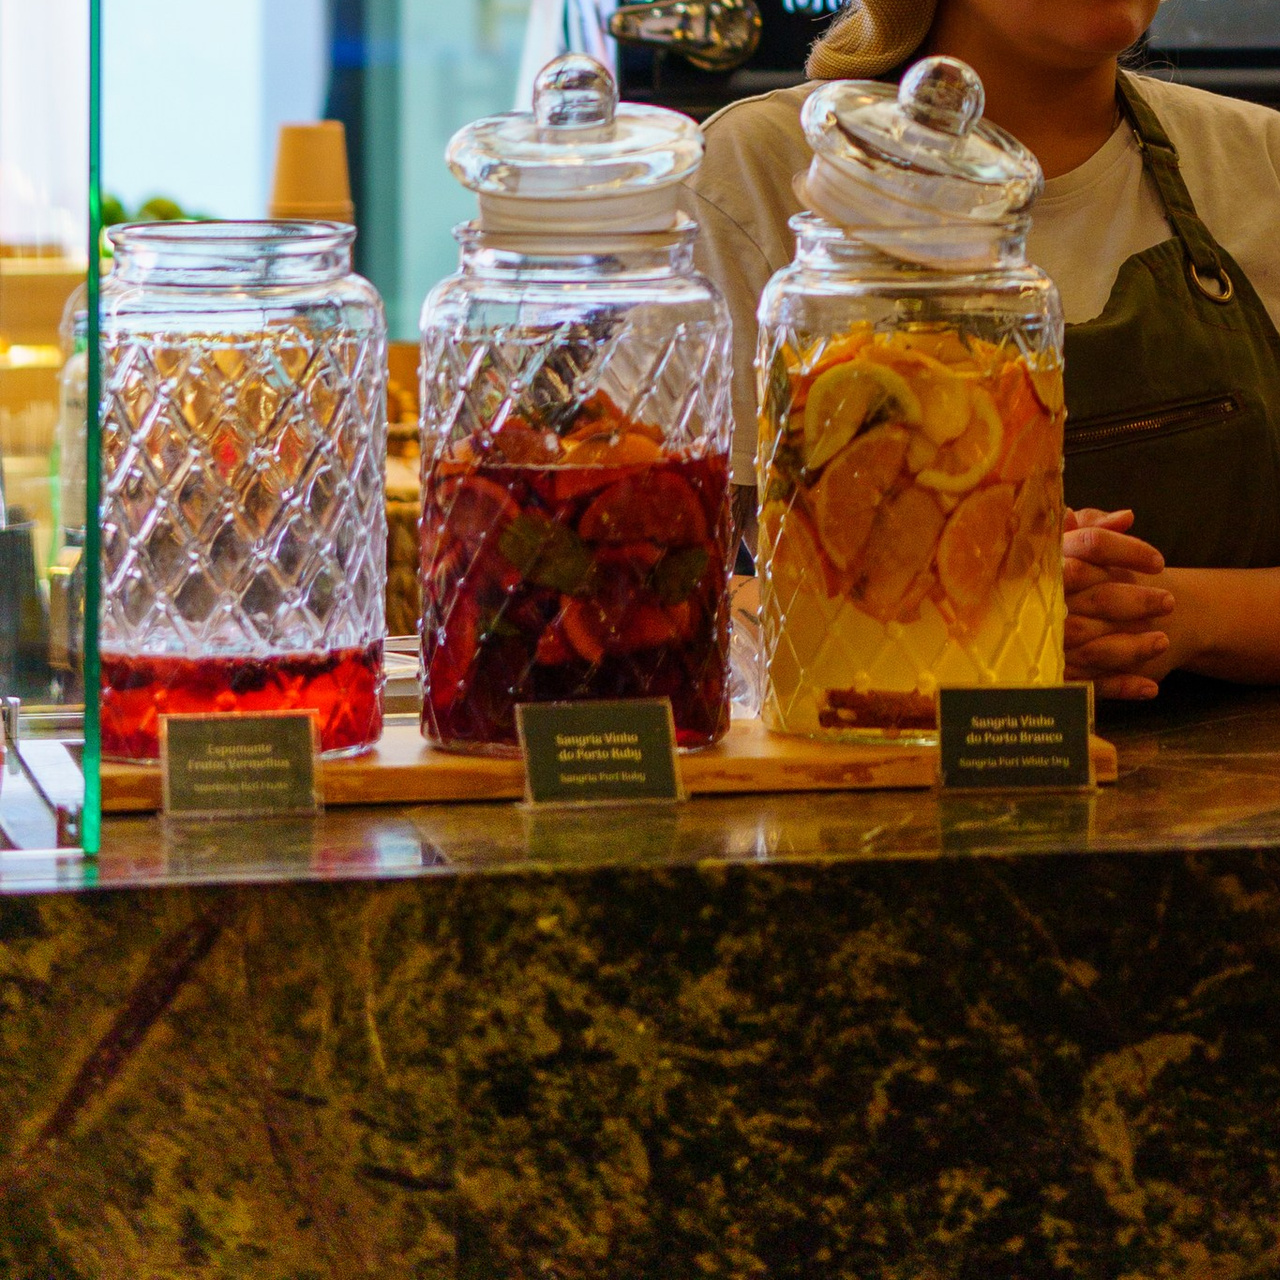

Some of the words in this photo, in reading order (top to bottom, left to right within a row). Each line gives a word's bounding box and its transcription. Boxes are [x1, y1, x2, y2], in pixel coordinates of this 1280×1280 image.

[970, 714, 1018, 730] Sangria
[1020, 713, 1055, 727] Vinho
[556, 733, 601, 748] Sangria
[604, 731, 638, 744] Vinho
[966, 732, 982, 745] do
[984, 732, 1018, 744] Porto
[1020, 731, 1063, 744] Branco
[559, 749, 574, 762] do
[576, 749, 609, 761] Porto
[611, 747, 642, 762] Ruby
